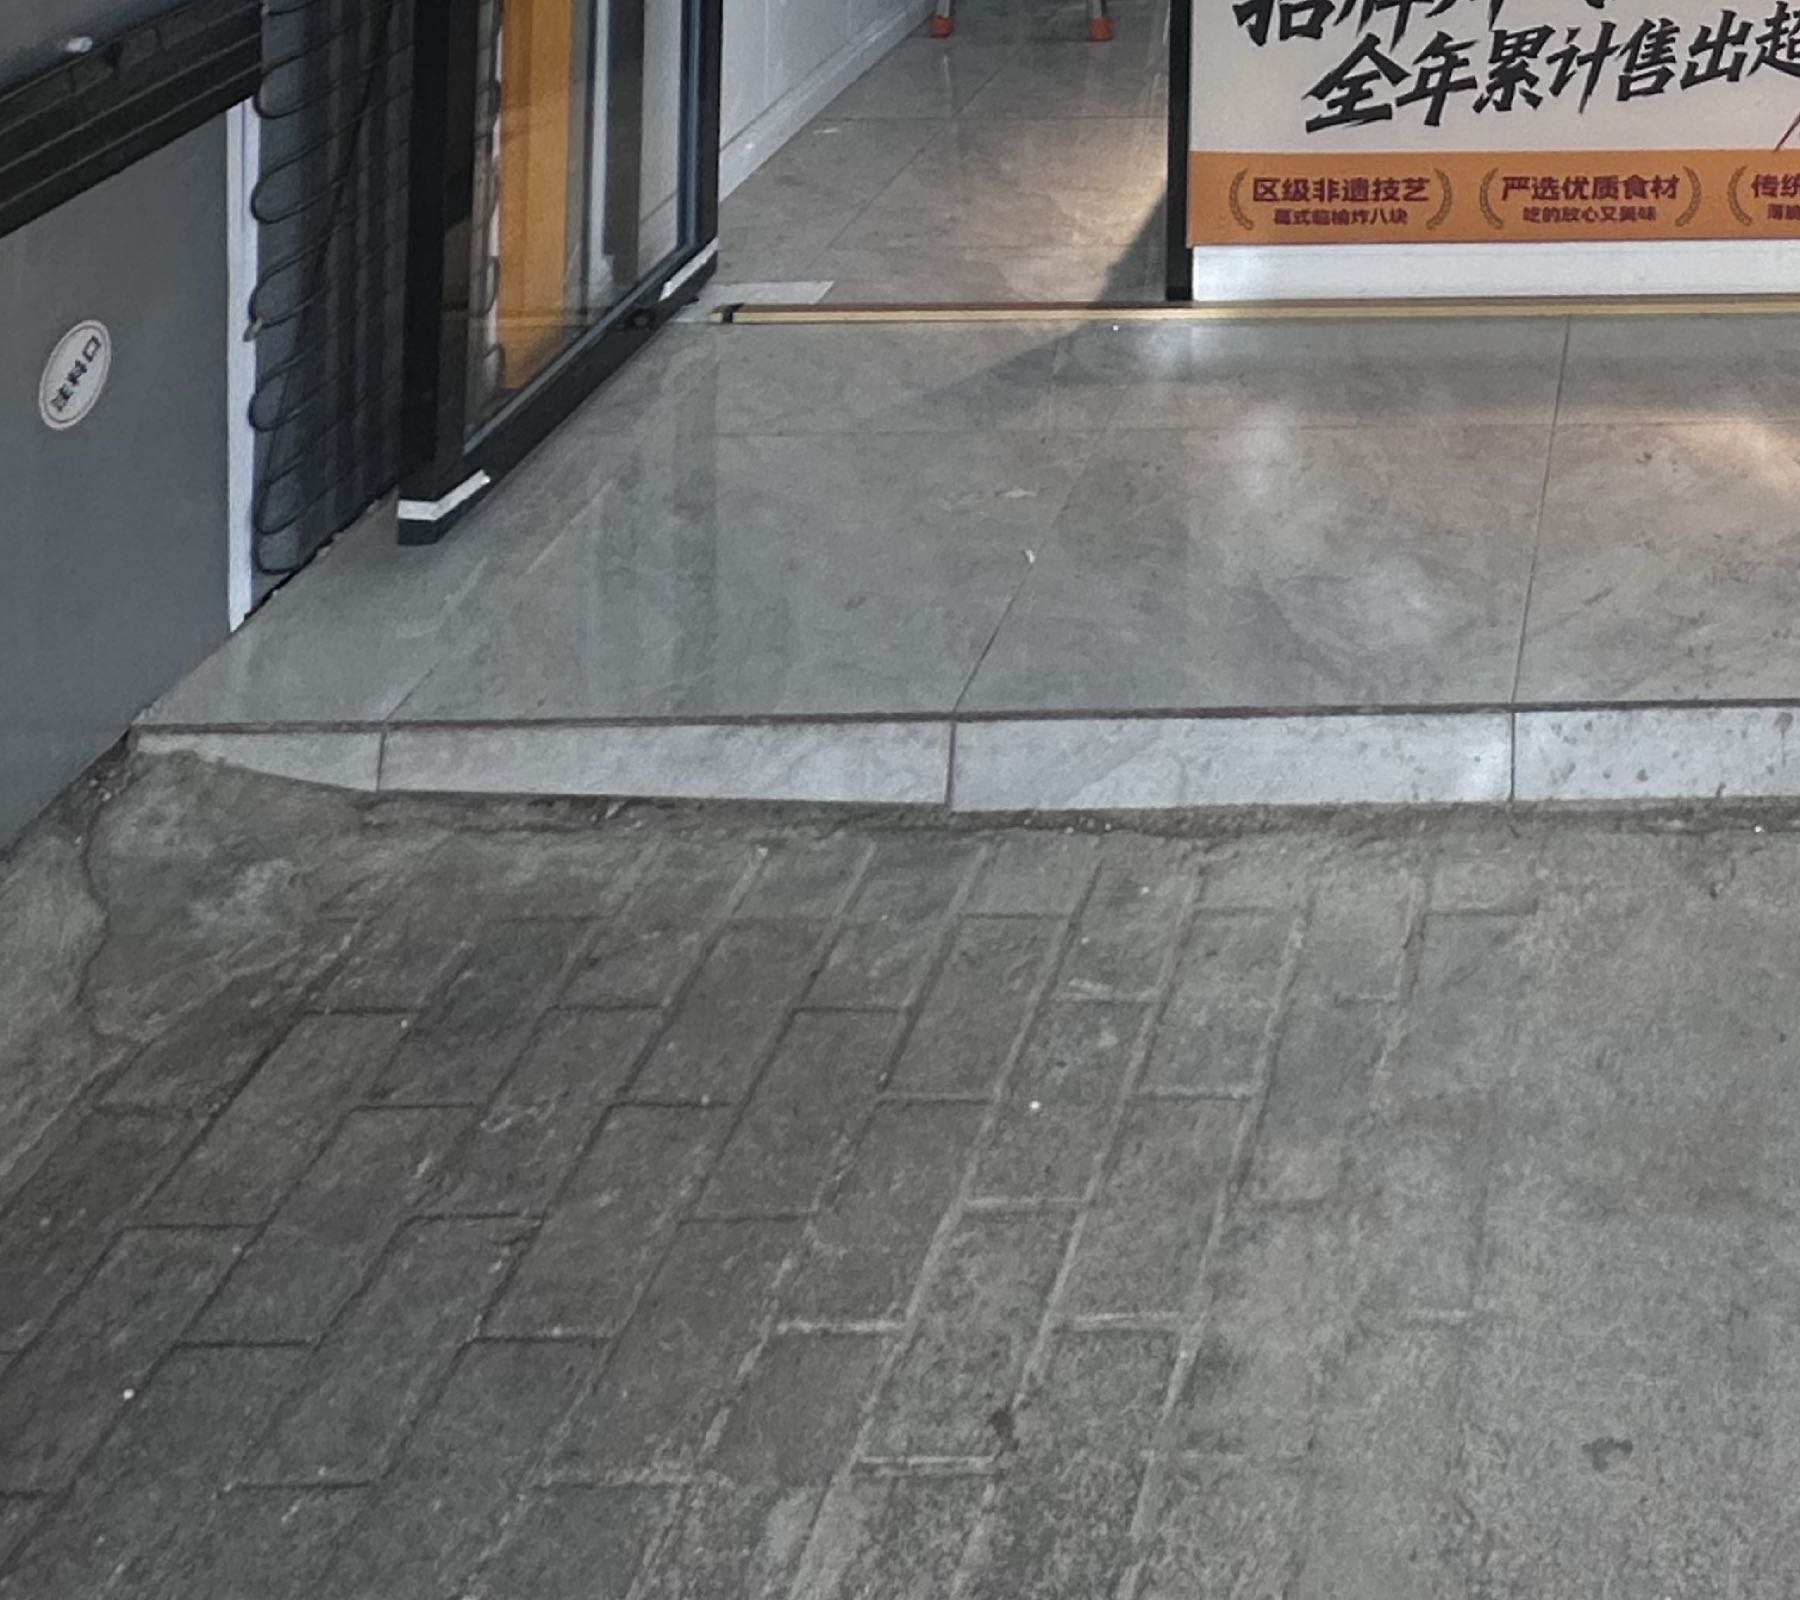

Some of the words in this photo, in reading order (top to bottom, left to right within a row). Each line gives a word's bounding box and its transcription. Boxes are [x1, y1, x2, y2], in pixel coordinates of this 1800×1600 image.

[1252, 177, 1430, 203] 区级非遗技艺
[1501, 175, 1680, 202] 严选优质食材
